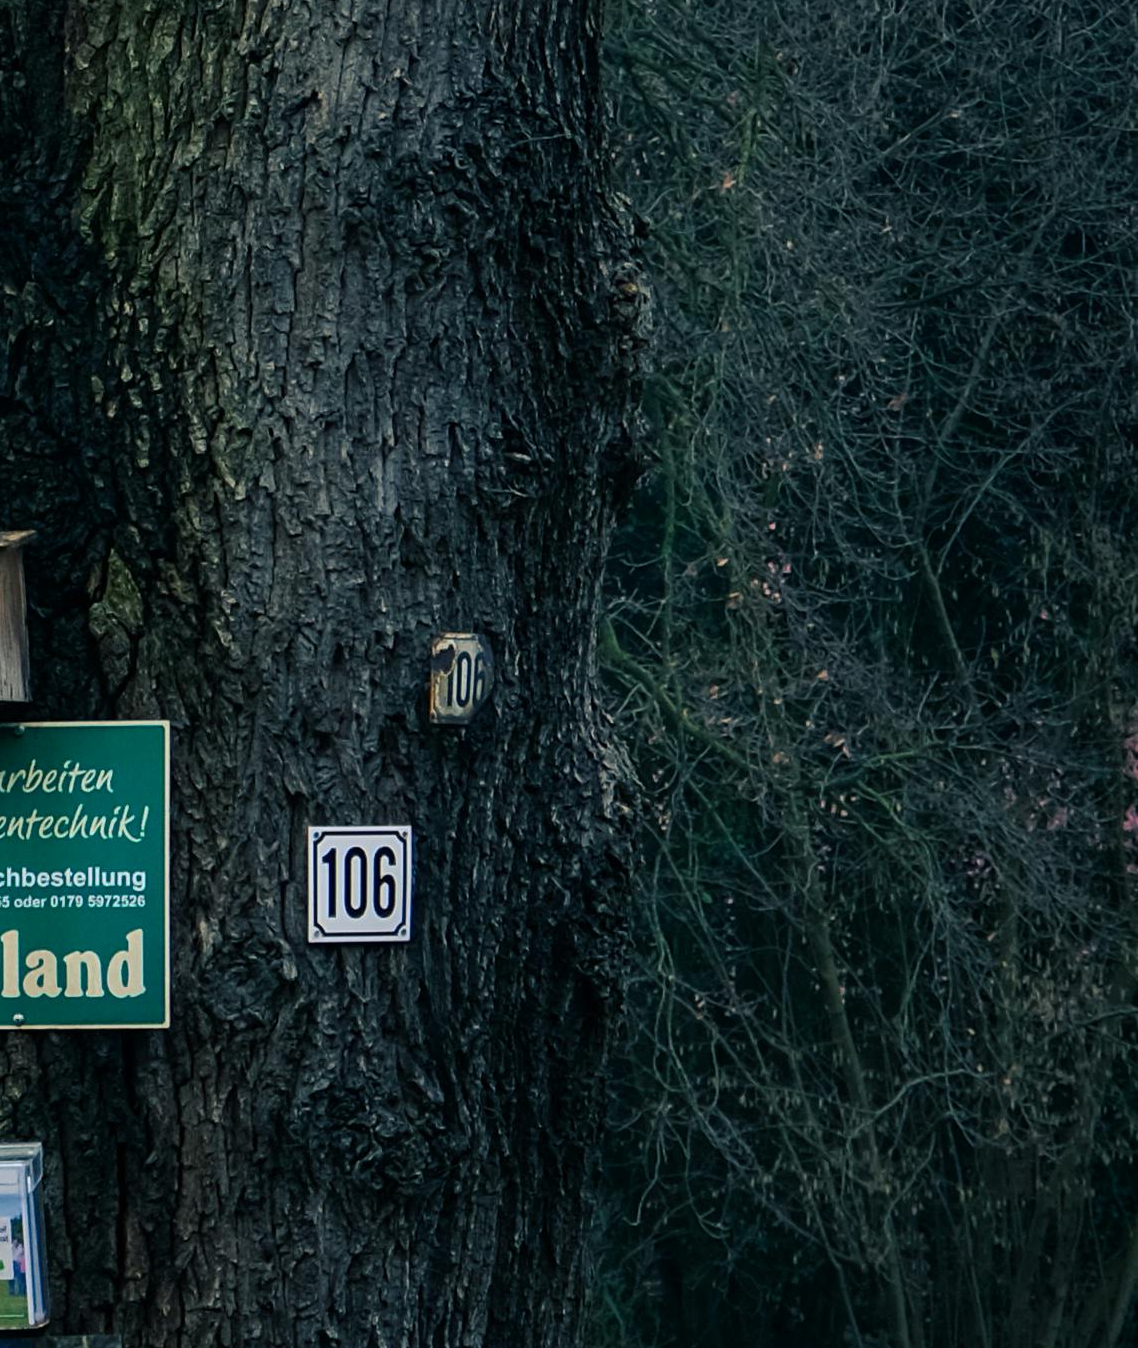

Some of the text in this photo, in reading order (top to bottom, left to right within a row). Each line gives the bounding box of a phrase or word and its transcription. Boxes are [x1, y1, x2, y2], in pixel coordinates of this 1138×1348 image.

[14, 895, 47, 908] oder
[50, 895, 83, 908] 0179
[321, 846, 397, 919] 106
